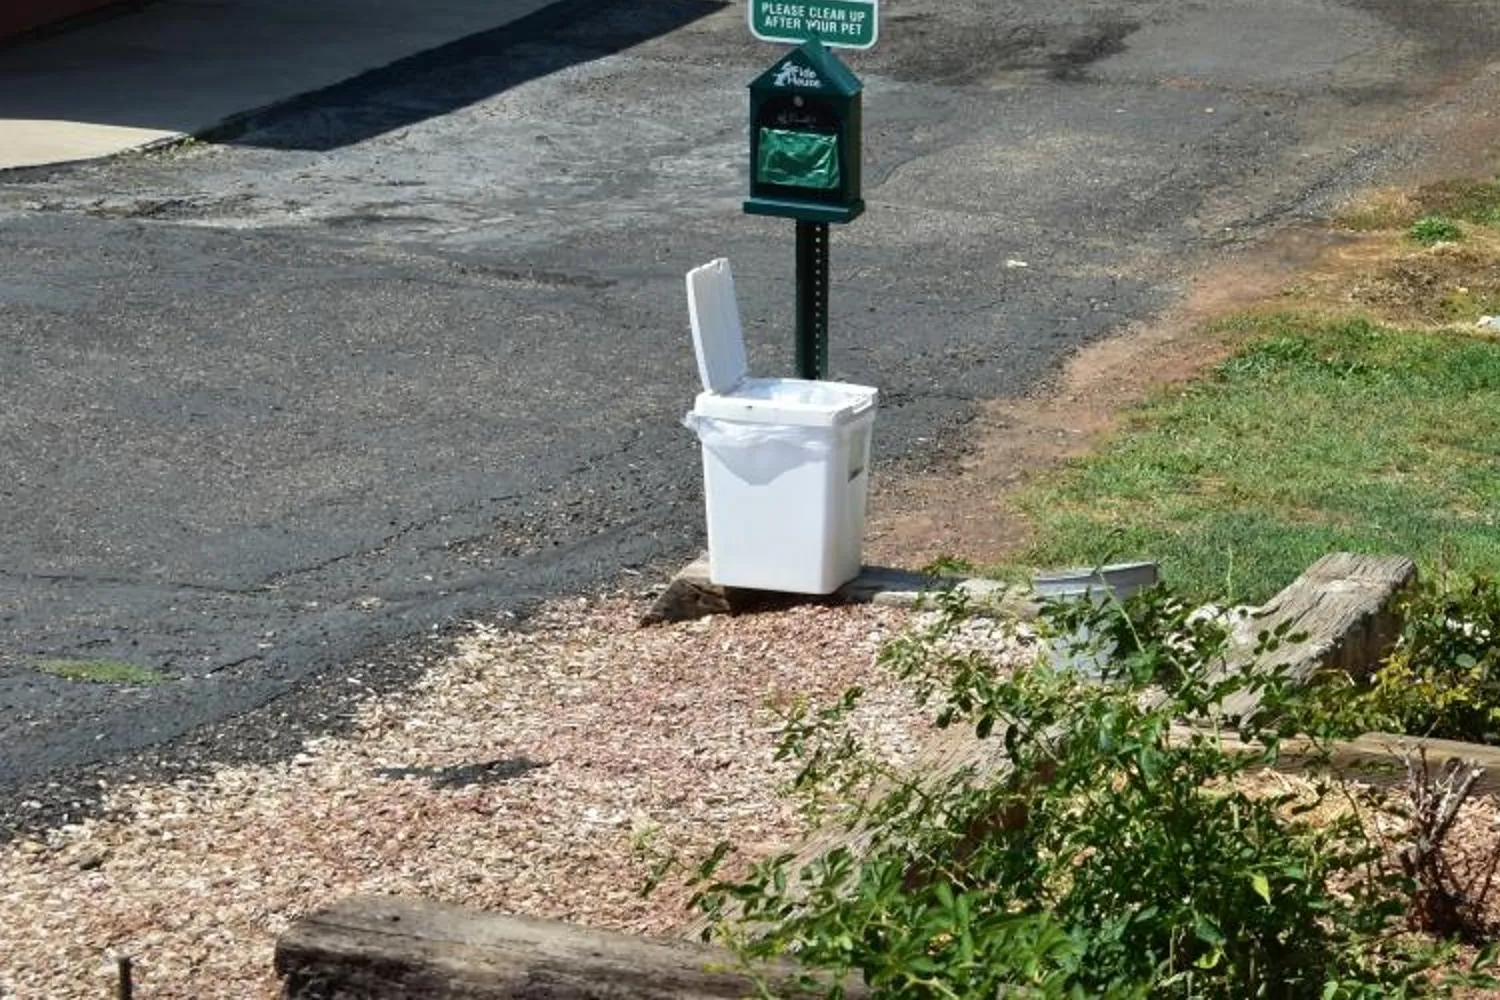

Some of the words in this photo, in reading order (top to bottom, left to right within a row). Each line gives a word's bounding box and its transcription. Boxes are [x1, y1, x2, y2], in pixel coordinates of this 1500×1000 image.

[761, 2, 804, 17] PLEASE
[809, 6, 845, 21] CLEAN
[849, 10, 865, 22] UP
[764, 15, 800, 29] AFTER
[805, 19, 837, 32] YOUR
[841, 22, 863, 35] PET
